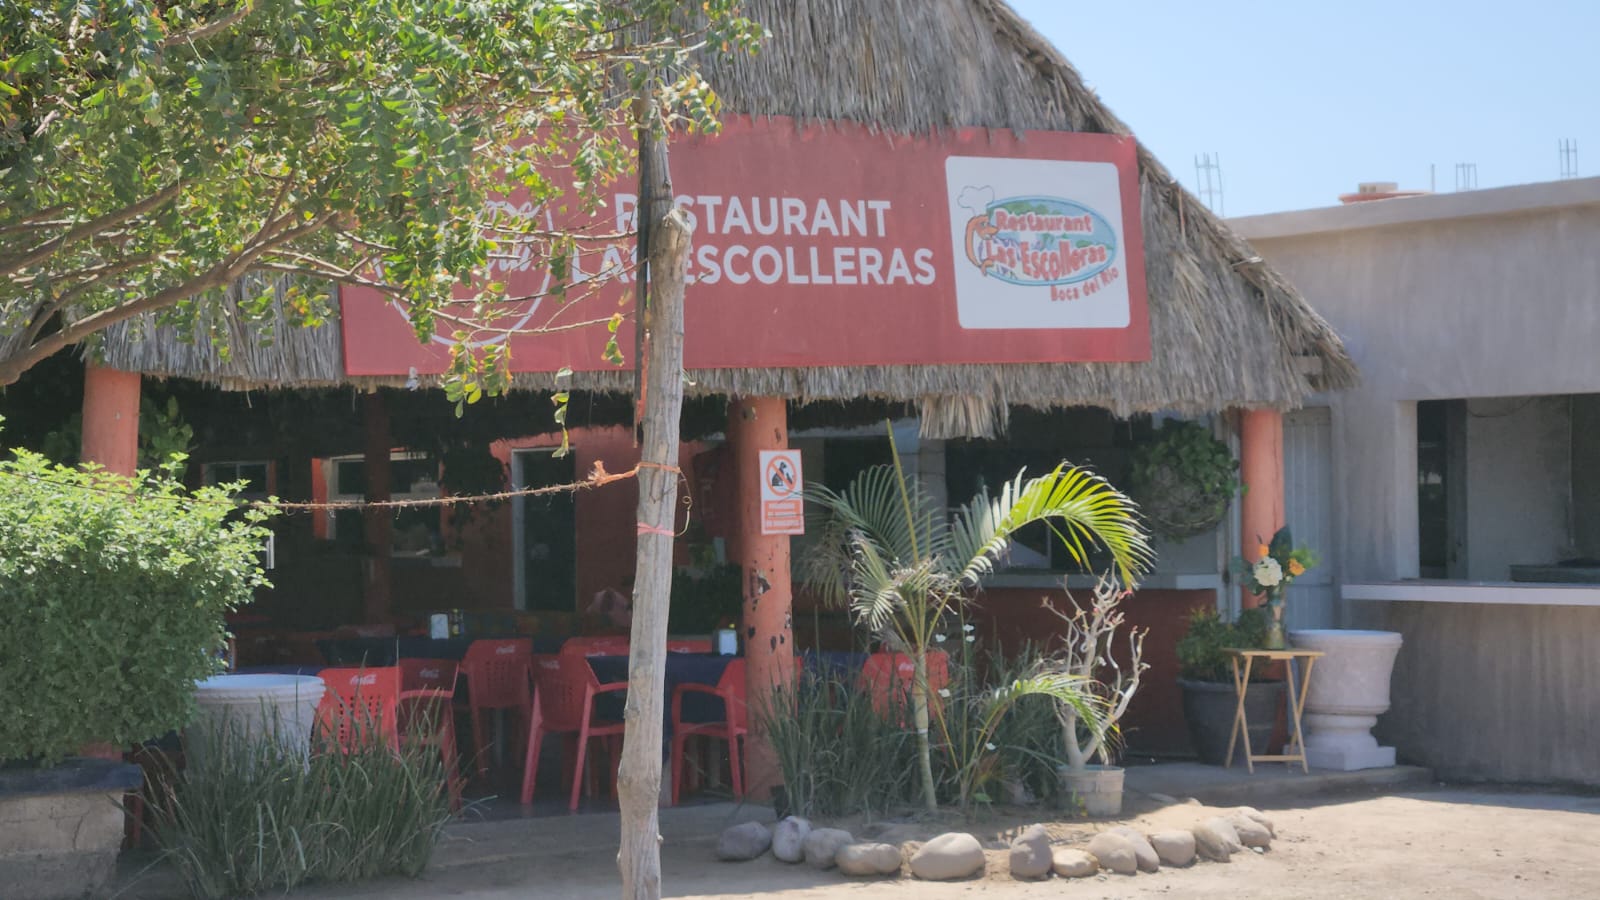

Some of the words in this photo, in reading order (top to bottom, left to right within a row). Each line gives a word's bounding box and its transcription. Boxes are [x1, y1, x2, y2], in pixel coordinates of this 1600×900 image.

[614, 193, 891, 237] RSTAURANT
[994, 210, 1092, 233] Restaurant
[984, 239, 1016, 269] Las
[1020, 240, 1107, 281] Escolleras
[1050, 284, 1079, 301] Boca
[1082, 277, 1100, 296] del
